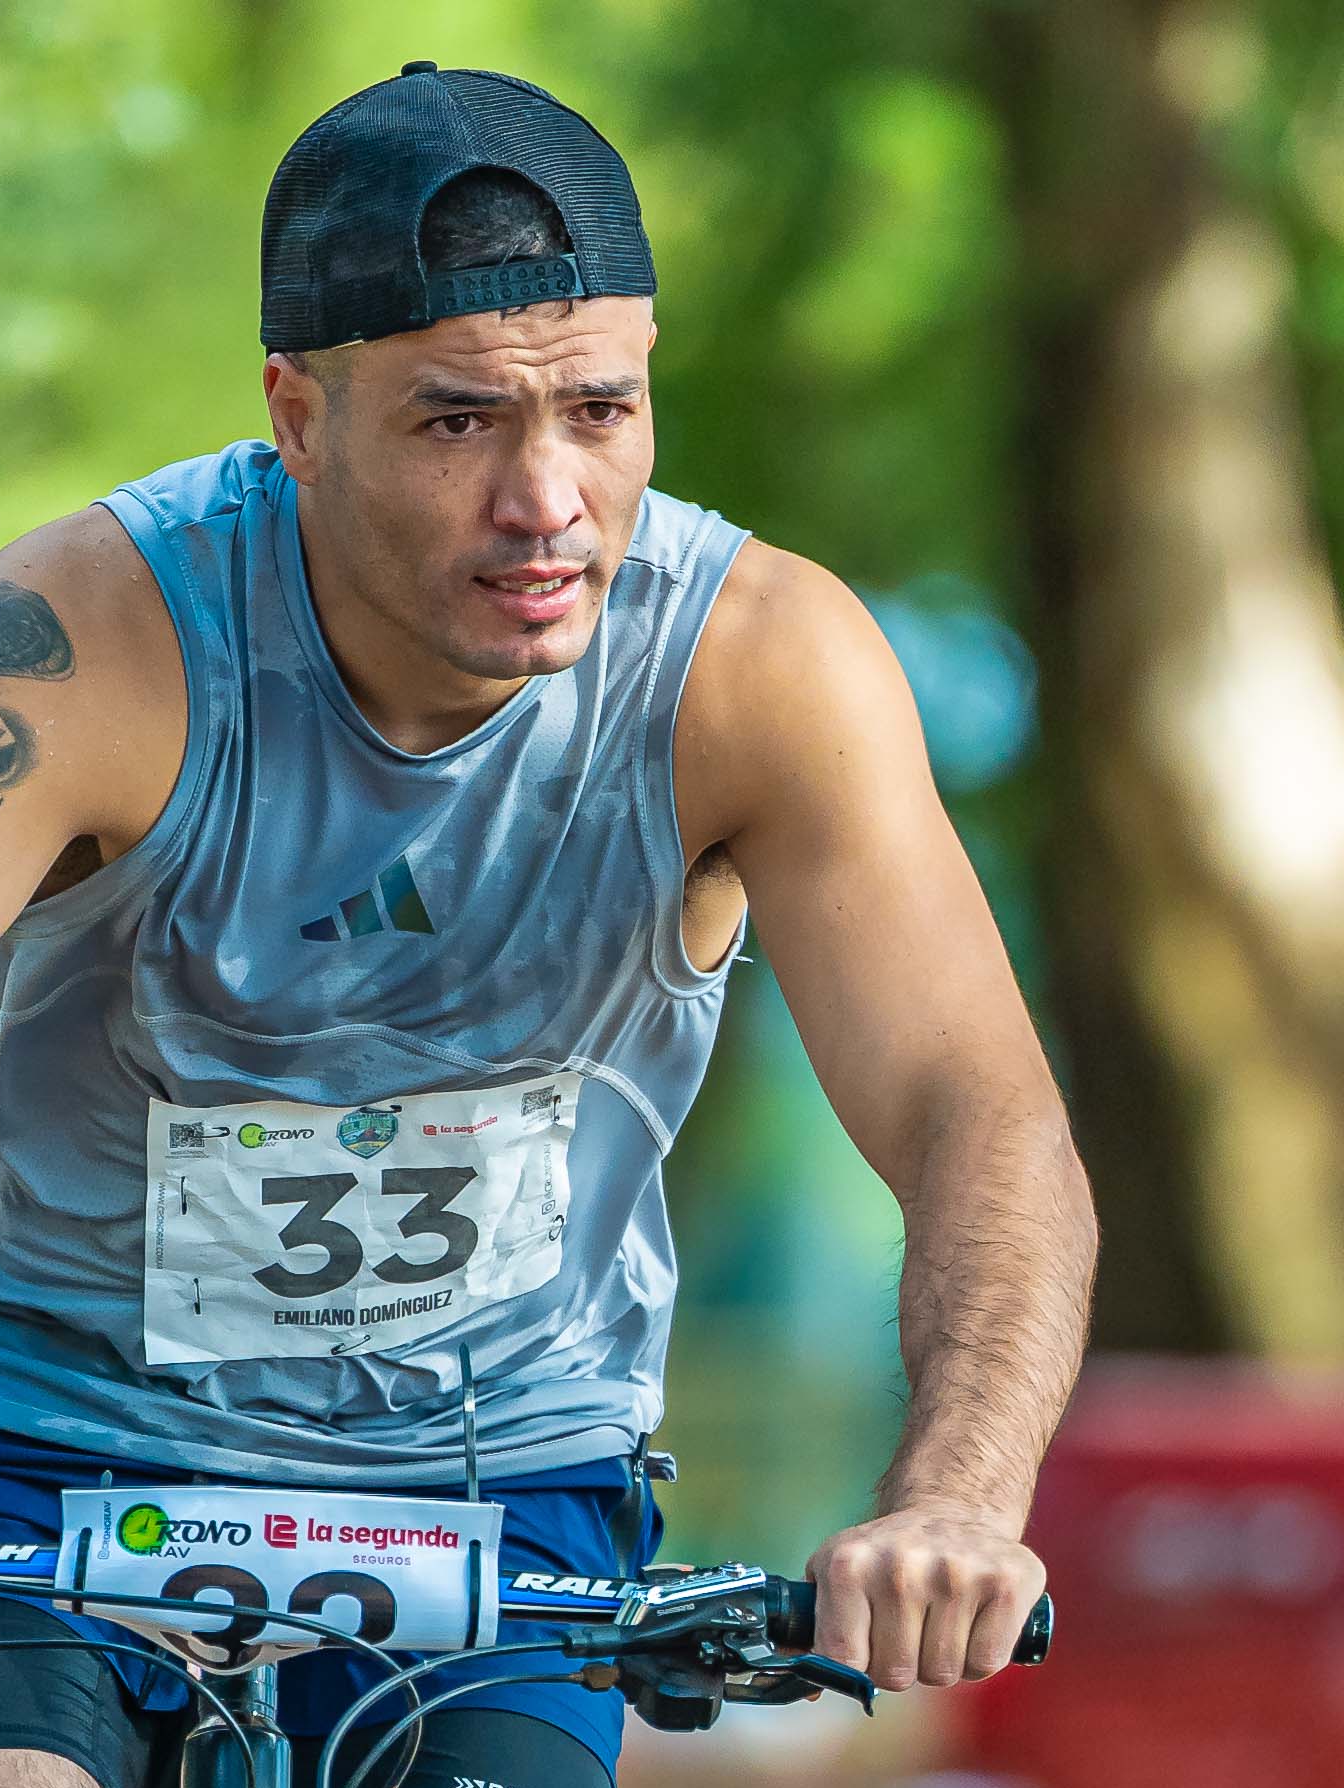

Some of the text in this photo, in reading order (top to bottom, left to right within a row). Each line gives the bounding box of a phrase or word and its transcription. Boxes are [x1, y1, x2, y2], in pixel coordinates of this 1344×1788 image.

[251, 1166, 479, 1298] 33
[273, 1289, 454, 1326] EMILIANO DOMÍNGUEZ
[308, 1518, 333, 1542] la
[338, 1525, 460, 1550] segunda
[149, 1546, 191, 1558] RAV
[353, 1554, 412, 1566] SEGUROS
